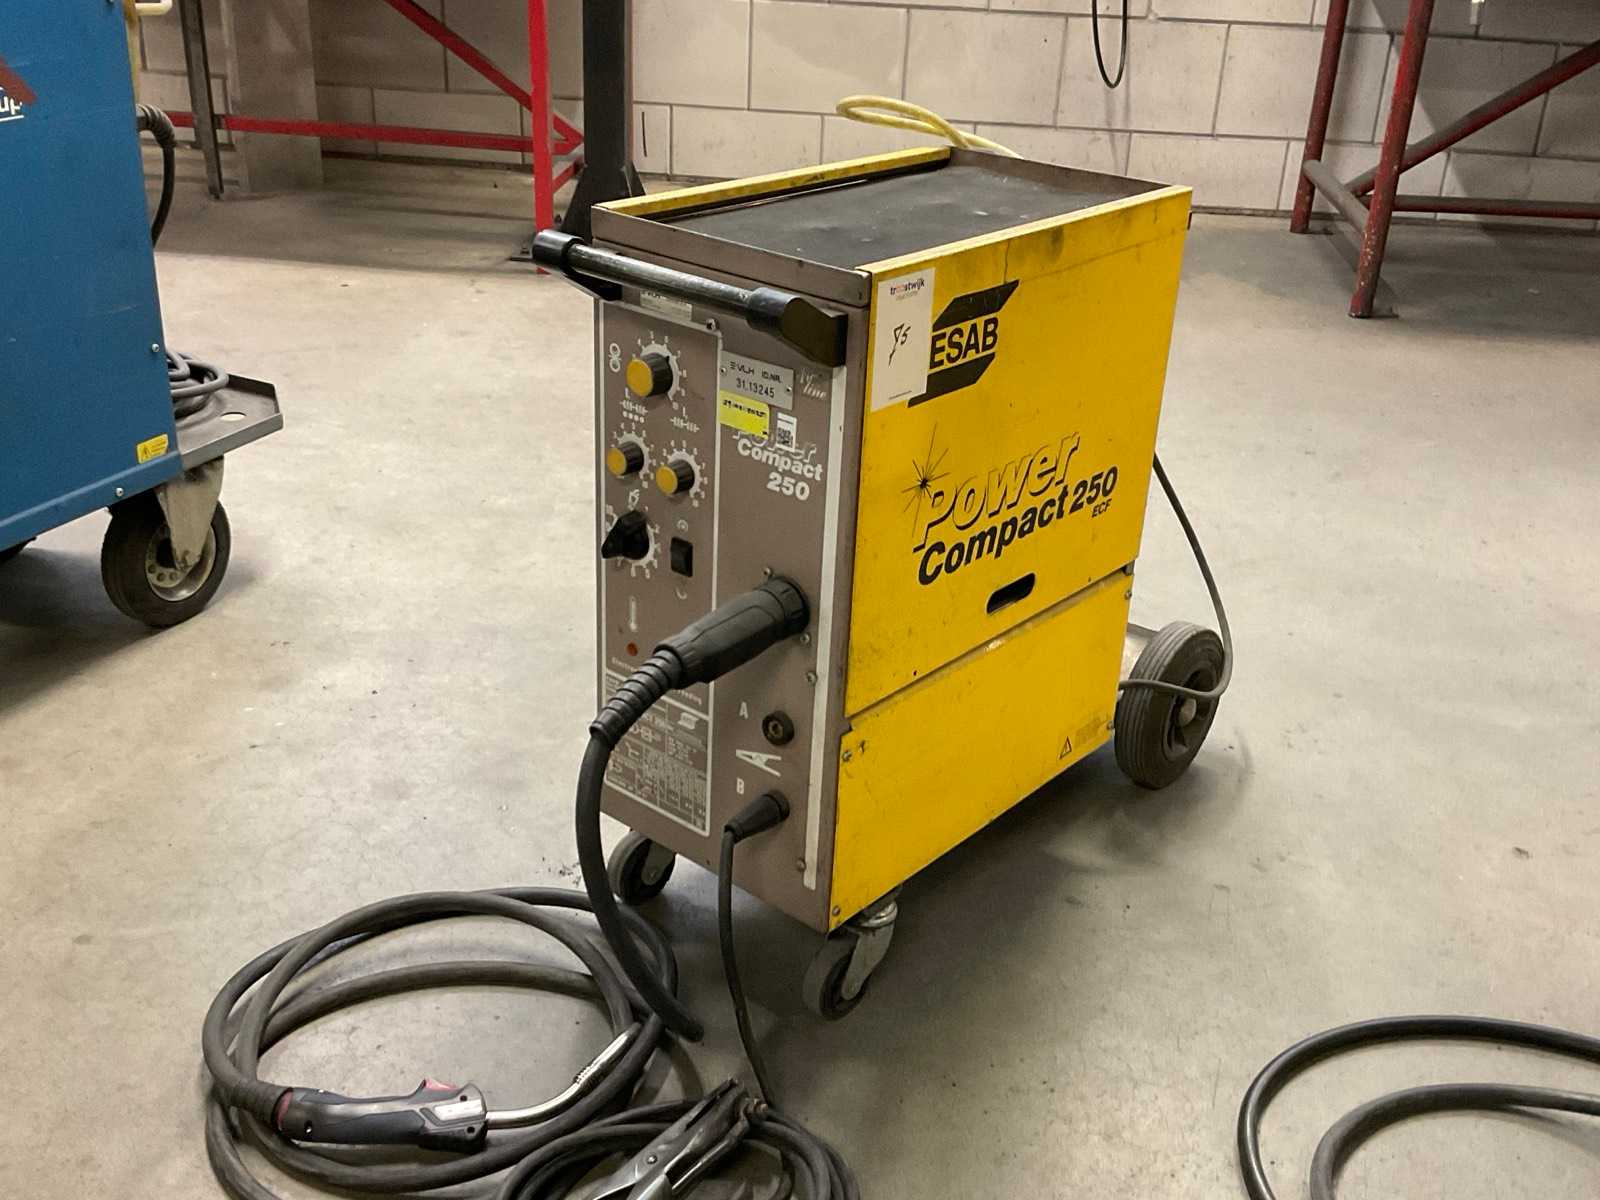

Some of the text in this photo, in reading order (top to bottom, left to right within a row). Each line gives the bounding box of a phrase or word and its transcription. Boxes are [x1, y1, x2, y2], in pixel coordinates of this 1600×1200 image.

[929, 316, 999, 370] ESAB
[737, 438, 823, 481] Compact
[766, 471, 810, 501] 250
[912, 431, 1081, 553] Power
[918, 465, 1118, 586] Compact 250
[739, 701, 749, 719] A
[736, 777, 745, 795] B
